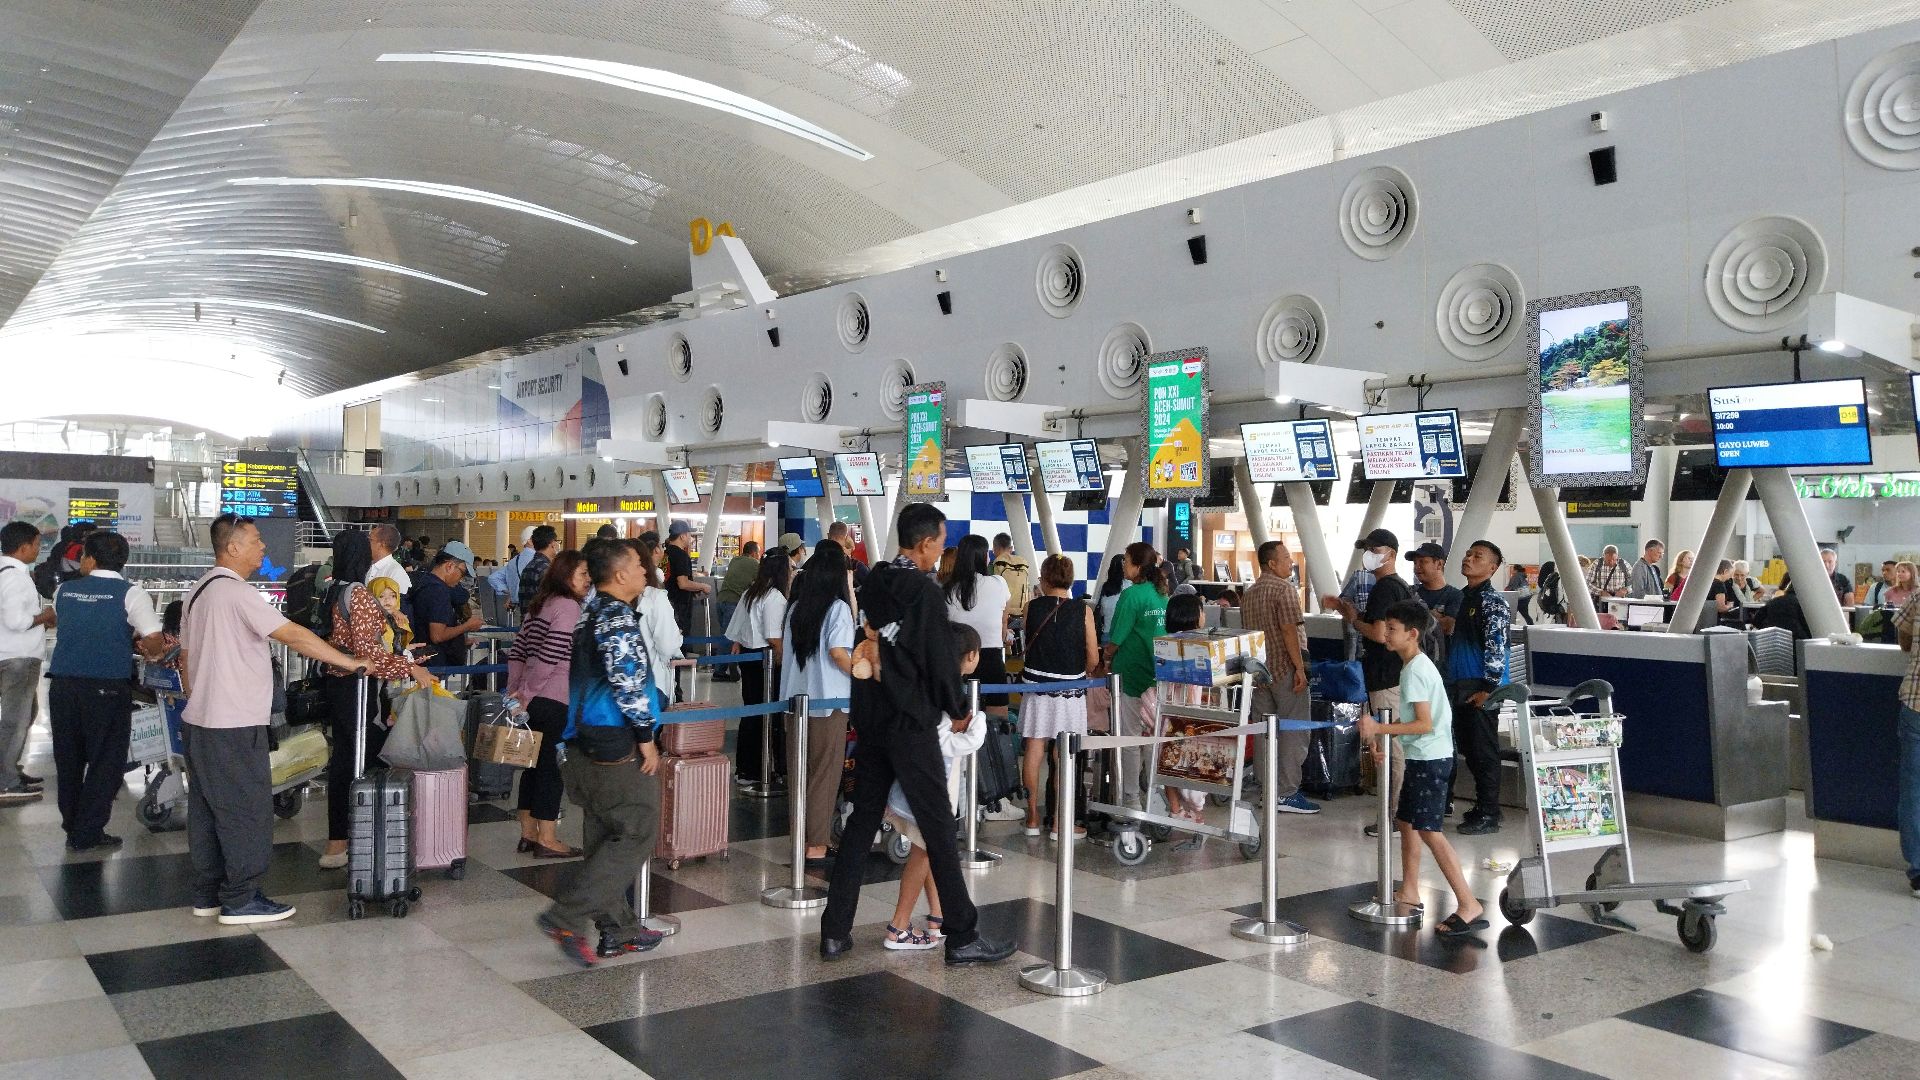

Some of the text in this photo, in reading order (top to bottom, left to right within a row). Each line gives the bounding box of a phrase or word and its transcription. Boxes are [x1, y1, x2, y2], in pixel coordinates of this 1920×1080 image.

[517, 373, 563, 399] AIRPORT SECURITY
[1154, 385, 1180, 400] PON XXI
[1154, 397, 1196, 413] ACEH-SUMUT
[1154, 413, 1171, 426] 2024
[1840, 411, 1858, 420] D18
[911, 421, 937, 434] ACEH-SUMUT
[1716, 422, 1734, 431] 10:00
[1718, 440, 1770, 450] GAYO LUWES
[1719, 450, 1741, 458] OPEN
[576, 500, 653, 513] Medan Napoleon
